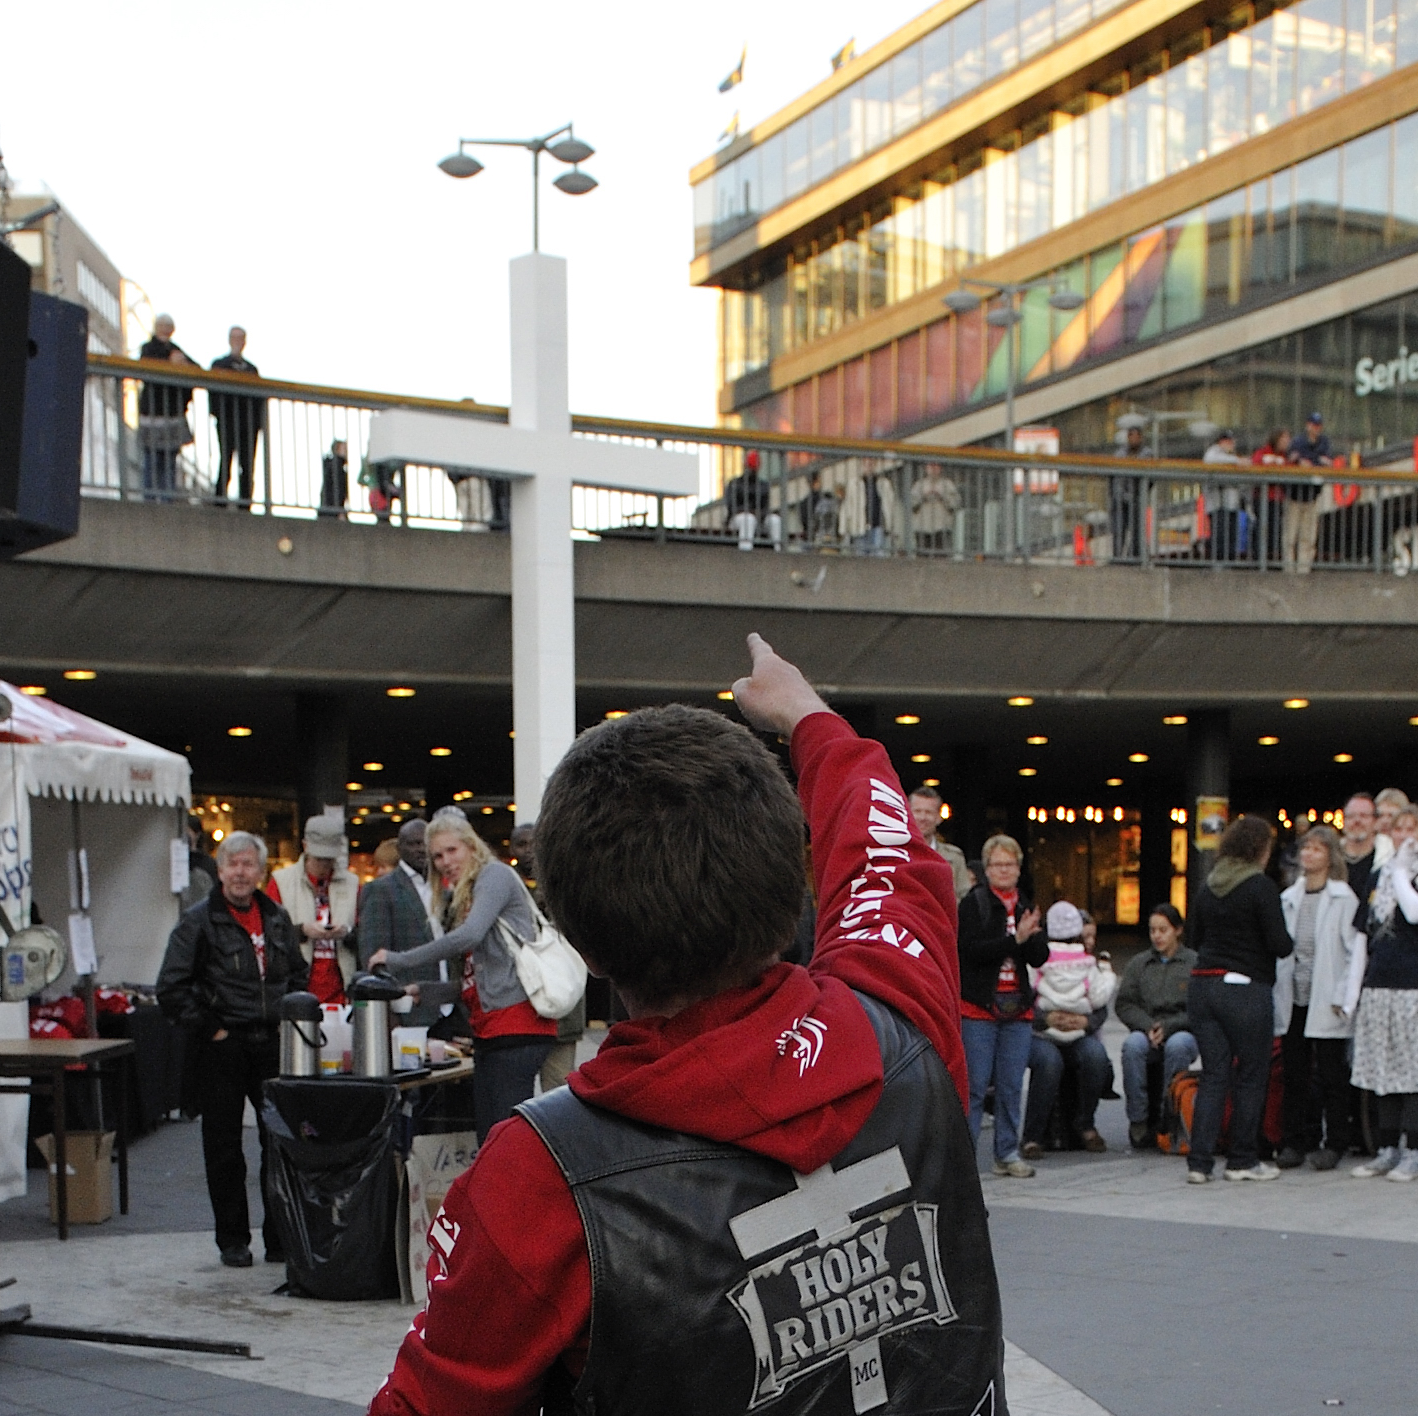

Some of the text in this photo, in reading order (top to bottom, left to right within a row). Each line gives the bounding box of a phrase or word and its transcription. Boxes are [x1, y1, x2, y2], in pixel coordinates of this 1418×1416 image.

[789, 1224, 891, 1310] HOLY
[773, 1260, 927, 1365] RIDERS
[853, 1358, 879, 1386] MC
